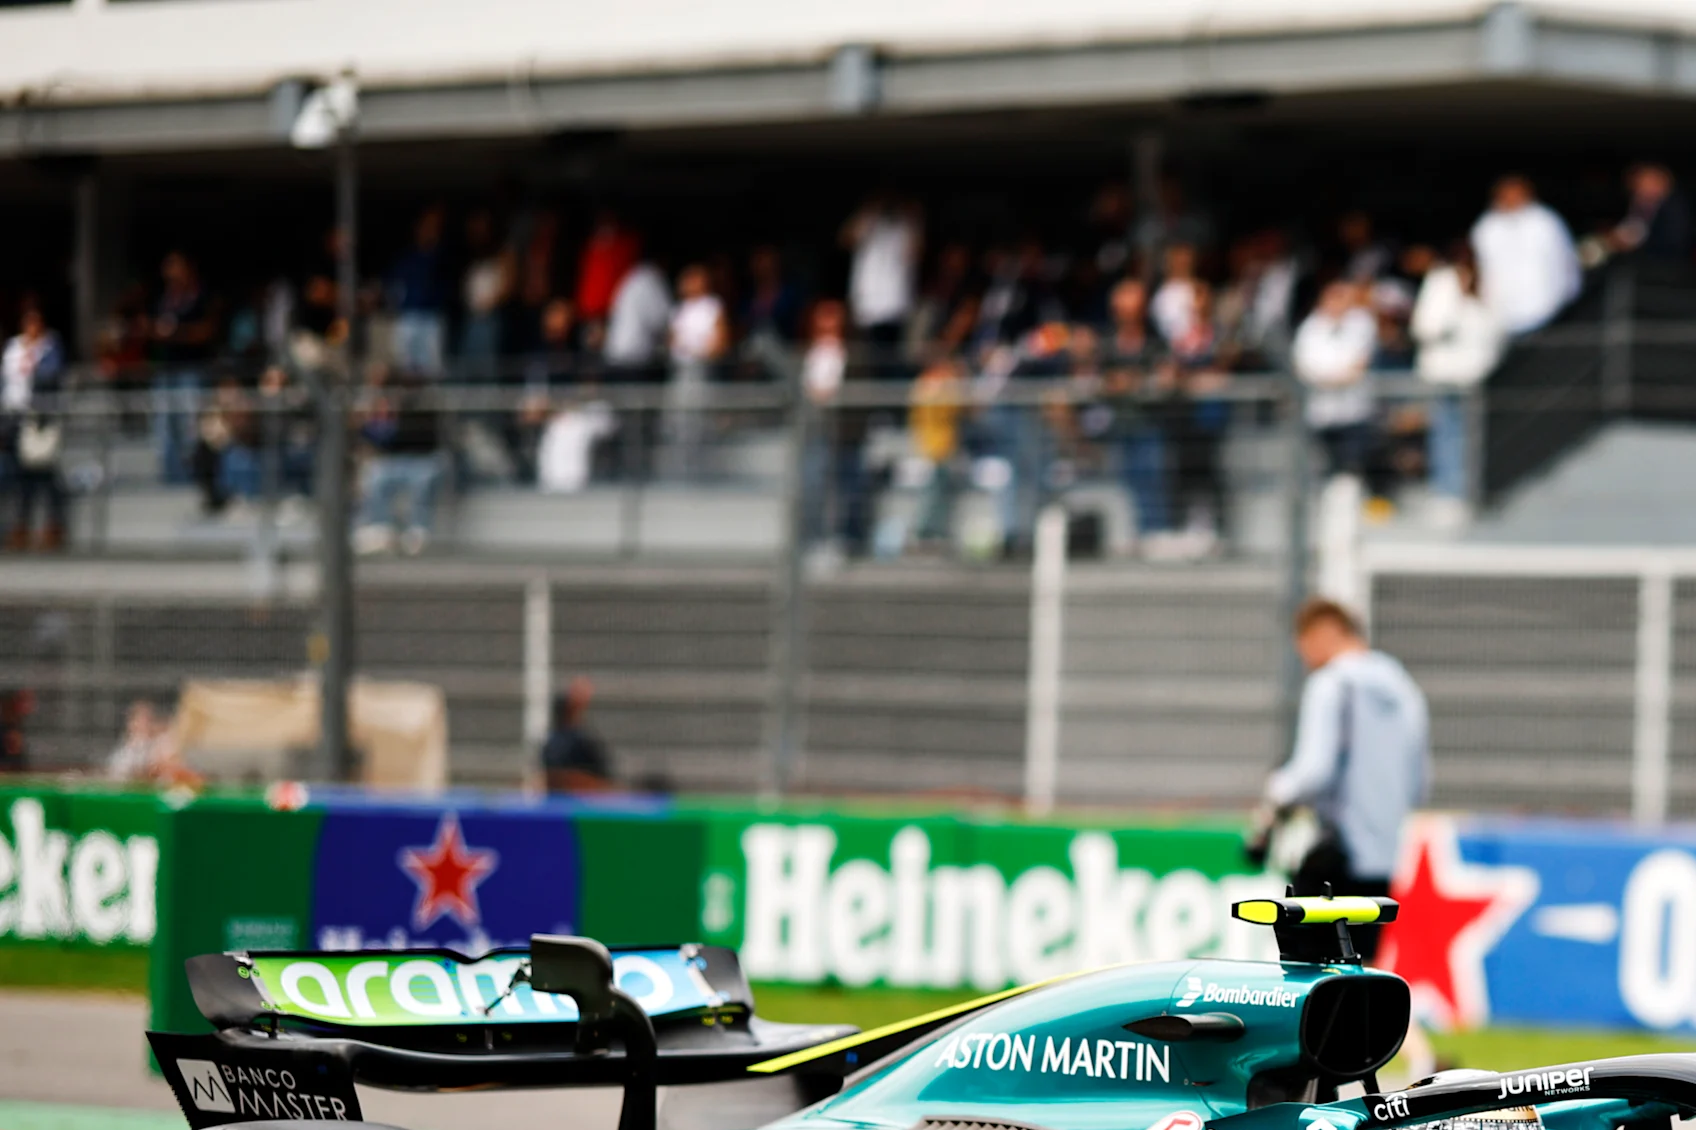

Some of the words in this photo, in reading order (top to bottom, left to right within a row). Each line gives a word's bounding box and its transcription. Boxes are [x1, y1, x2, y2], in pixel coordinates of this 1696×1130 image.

[281, 958, 674, 1018] aramo
[1203, 983, 1300, 1008] Bombardier
[935, 1032, 1036, 1072] ASTON
[1041, 1035, 1170, 1083] MARTIN
[221, 1064, 297, 1090] BANCO
[1545, 1085, 1591, 1096] NETWORKS
[239, 1088, 347, 1121] MASTER
[1374, 1092, 1411, 1121] citi
